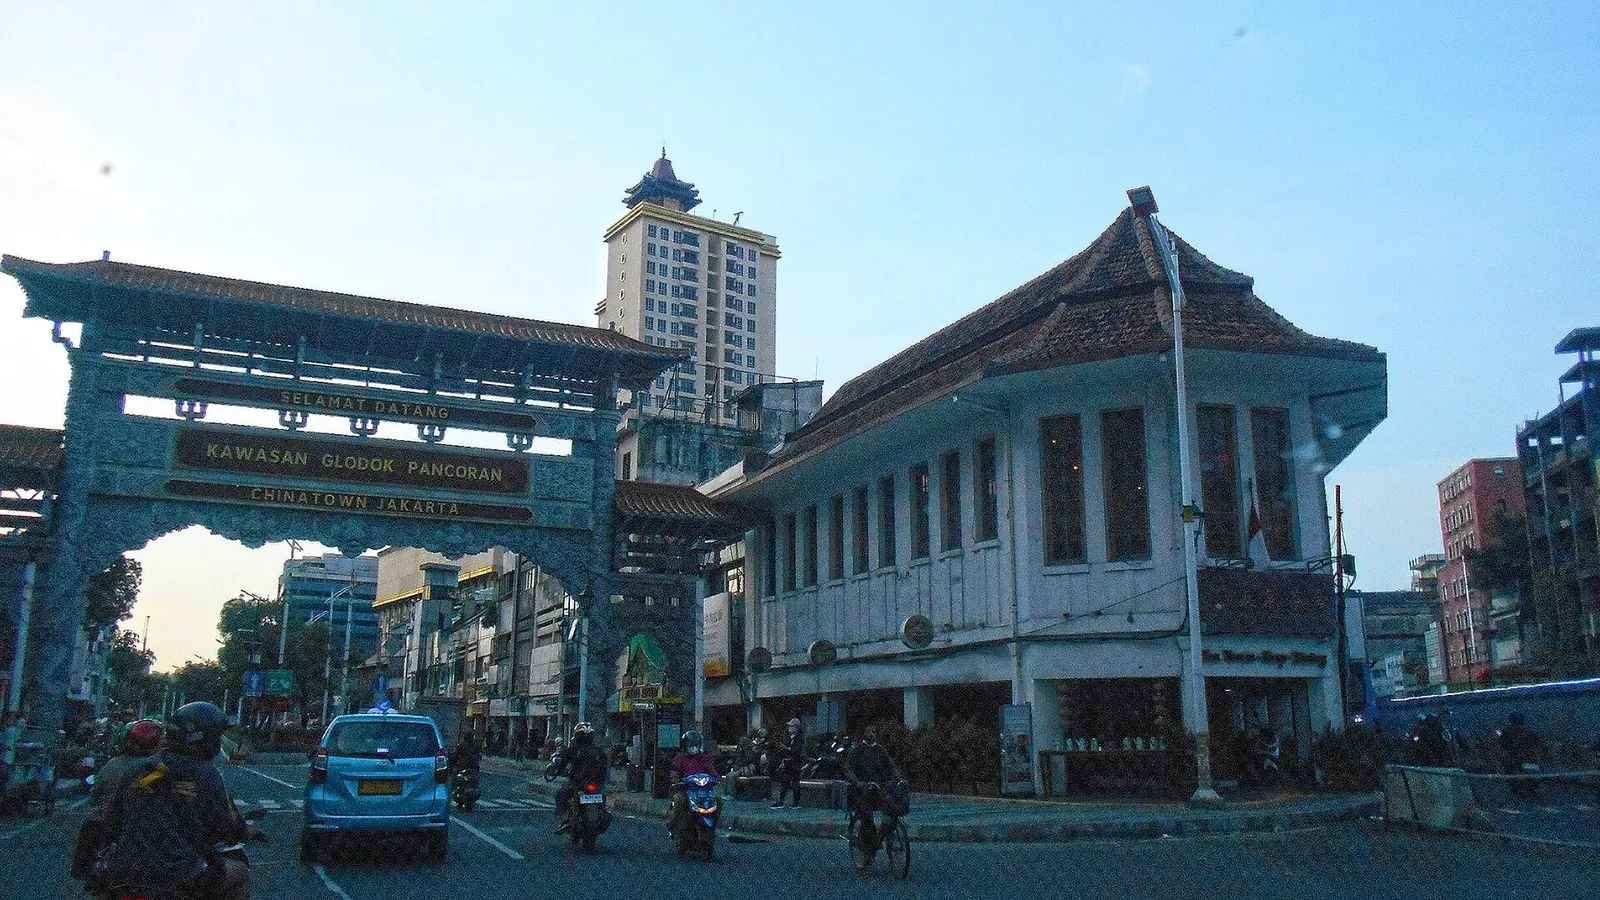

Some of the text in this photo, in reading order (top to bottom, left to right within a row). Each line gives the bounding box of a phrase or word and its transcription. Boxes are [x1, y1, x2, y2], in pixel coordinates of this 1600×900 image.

[280, 391, 449, 418] SELAMAT DATANG
[206, 443, 503, 482] KAWASAN GLODOK PANCORAN
[251, 488, 459, 515] CHINATOWN JAKARTA
